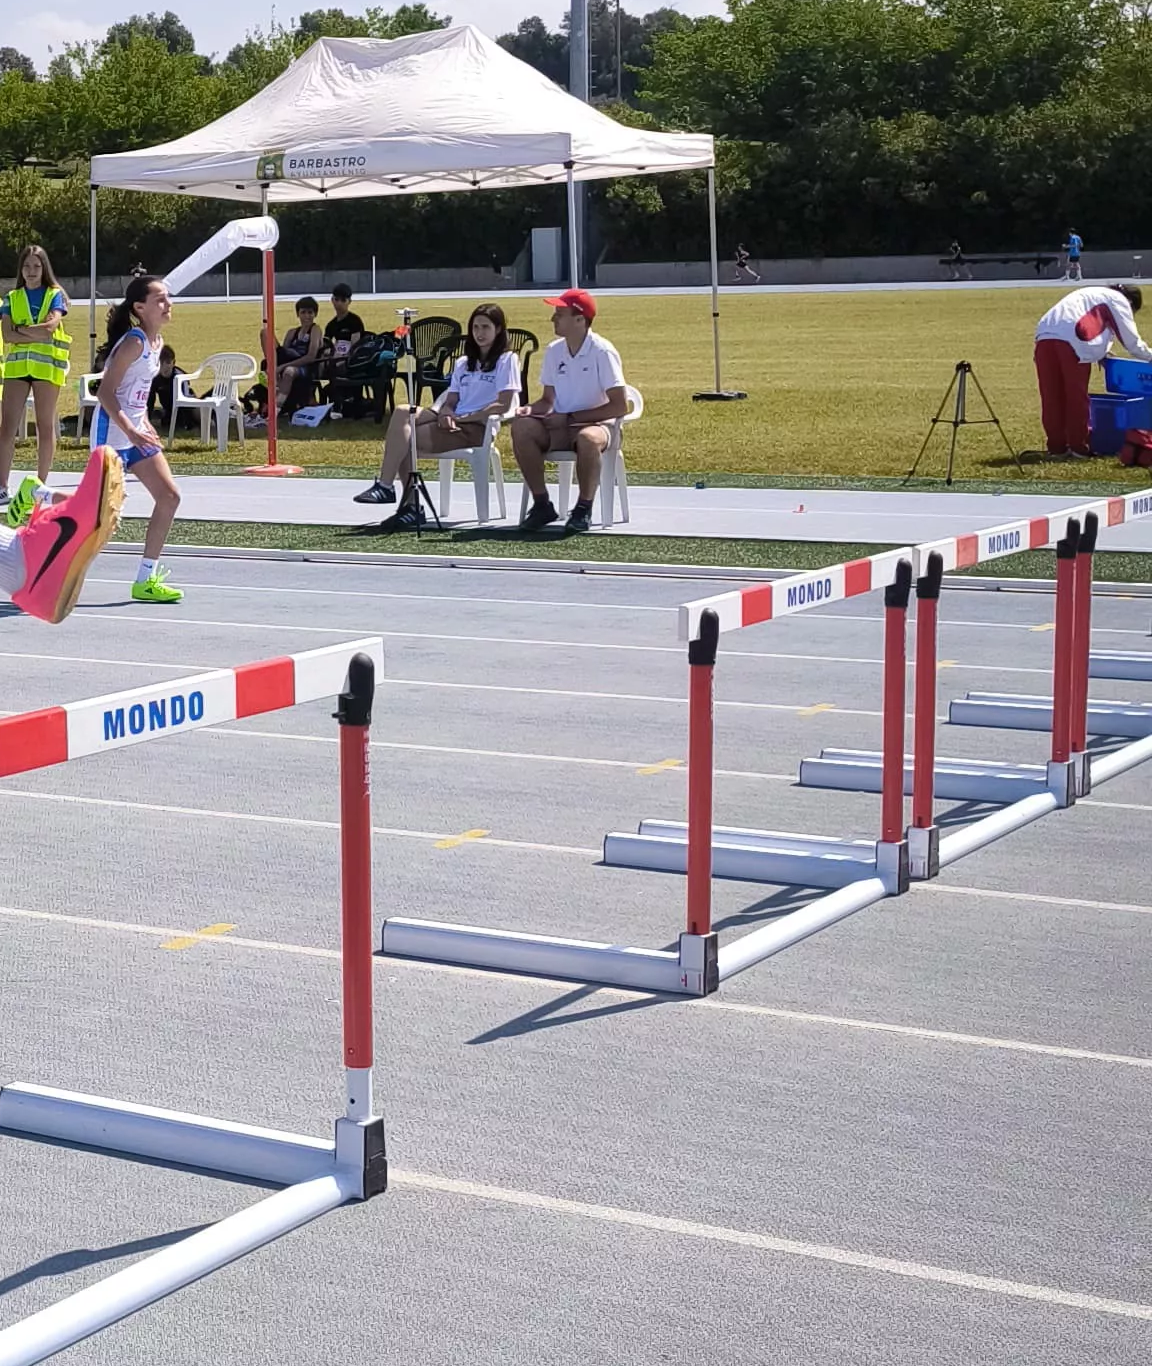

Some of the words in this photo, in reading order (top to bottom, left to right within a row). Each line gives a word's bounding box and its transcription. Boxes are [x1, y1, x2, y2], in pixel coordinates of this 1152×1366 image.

[289, 156, 366, 169] BARBASTRO
[988, 530, 1021, 554] MONDO
[788, 578, 832, 608] MONDO
[103, 690, 204, 741] MONDO
